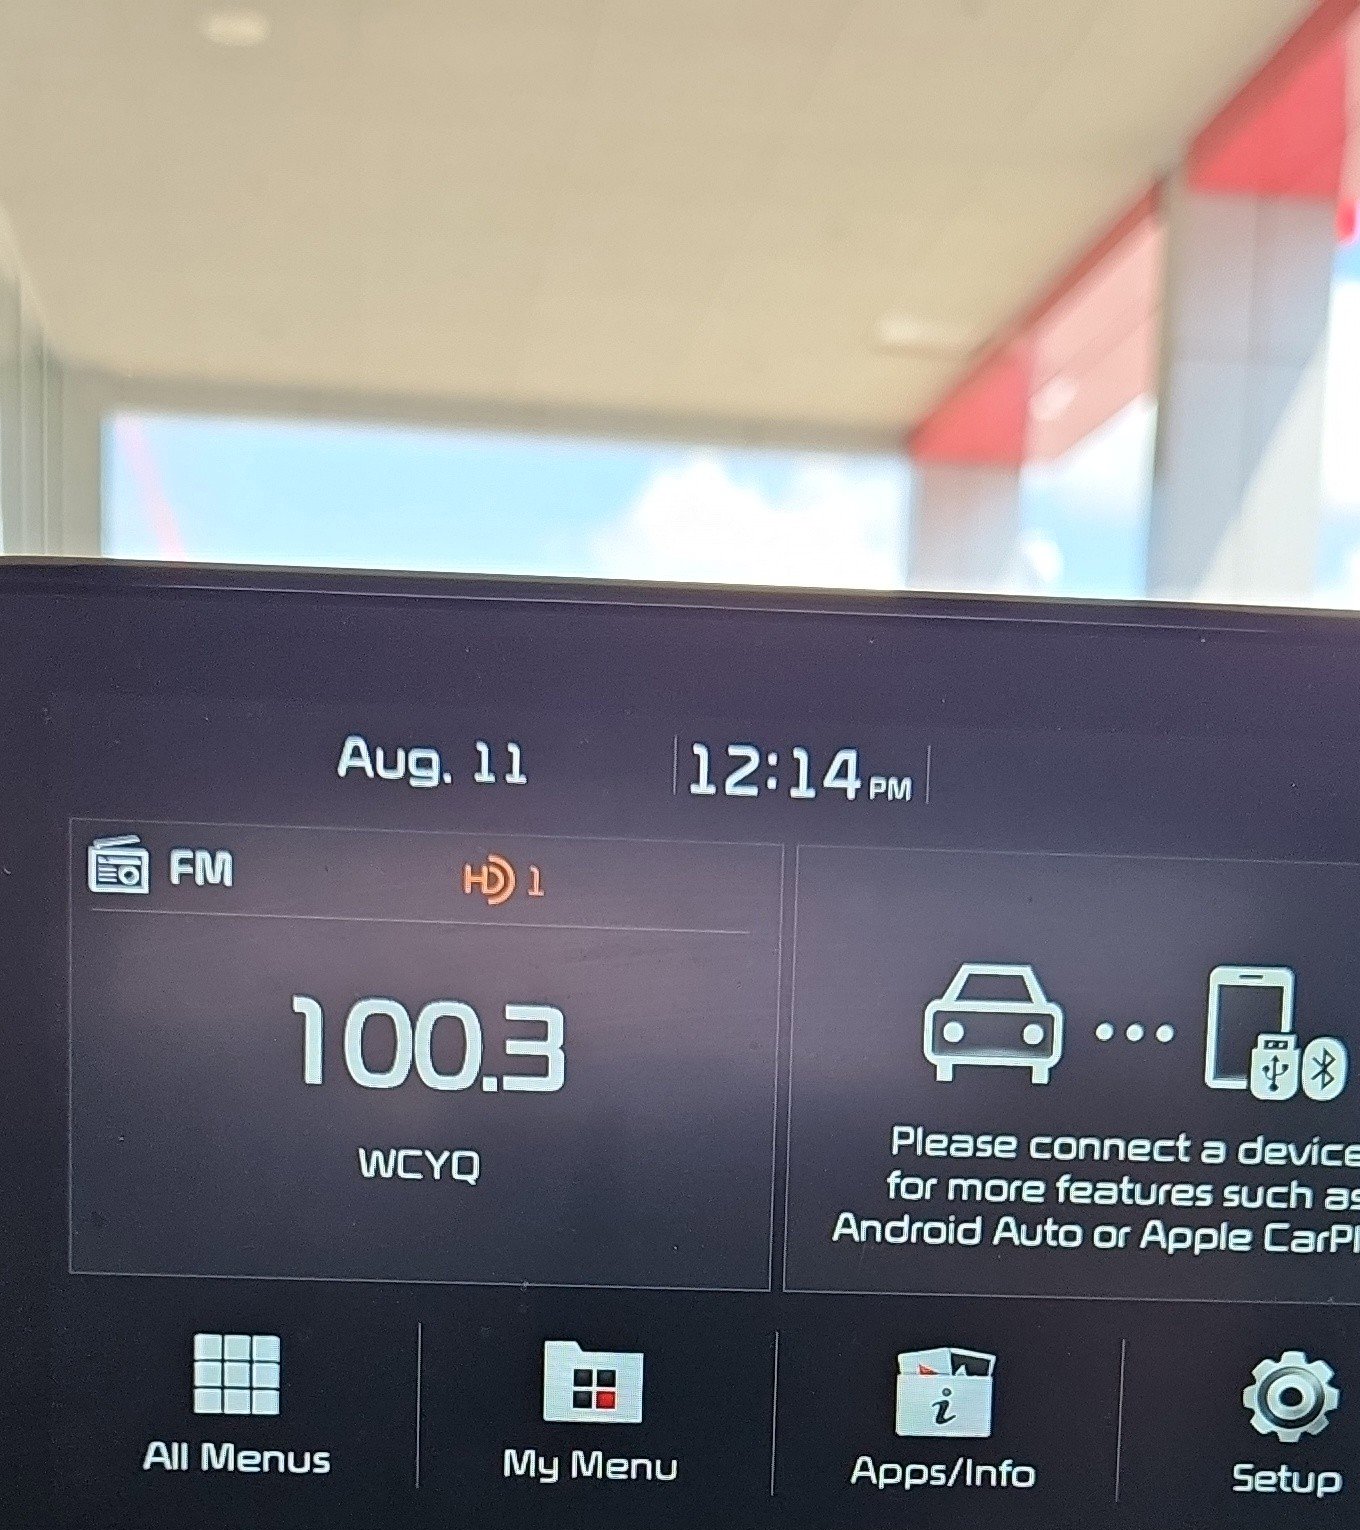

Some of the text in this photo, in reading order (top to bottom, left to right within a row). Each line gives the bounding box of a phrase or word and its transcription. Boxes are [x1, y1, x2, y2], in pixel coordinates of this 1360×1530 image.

[337, 736, 527, 788] Aug. 11
[690, 743, 912, 801] 12:14 PM
[170, 849, 233, 887] FM
[528, 866, 544, 896] 1
[292, 995, 565, 1092] 100.3
[892, 1125, 1018, 1158] Please
[1029, 1133, 1192, 1163] connect
[1200, 1140, 1227, 1164] a
[358, 1147, 480, 1185] WCYQ
[886, 1169, 938, 1200] for
[947, 1178, 1046, 1203] more
[1055, 1174, 1213, 1207] features
[1223, 1180, 1313, 1209] such
[832, 1211, 982, 1245] Android
[992, 1215, 1083, 1248] Auto
[1093, 1225, 1132, 1249] or
[1139, 1219, 1253, 1255] Apple
[142, 1441, 331, 1474] All Menus
[503, 1448, 678, 1484] My Menu
[850, 1455, 1036, 1490] Apps/Info
[1232, 1463, 1343, 1498] Setup
